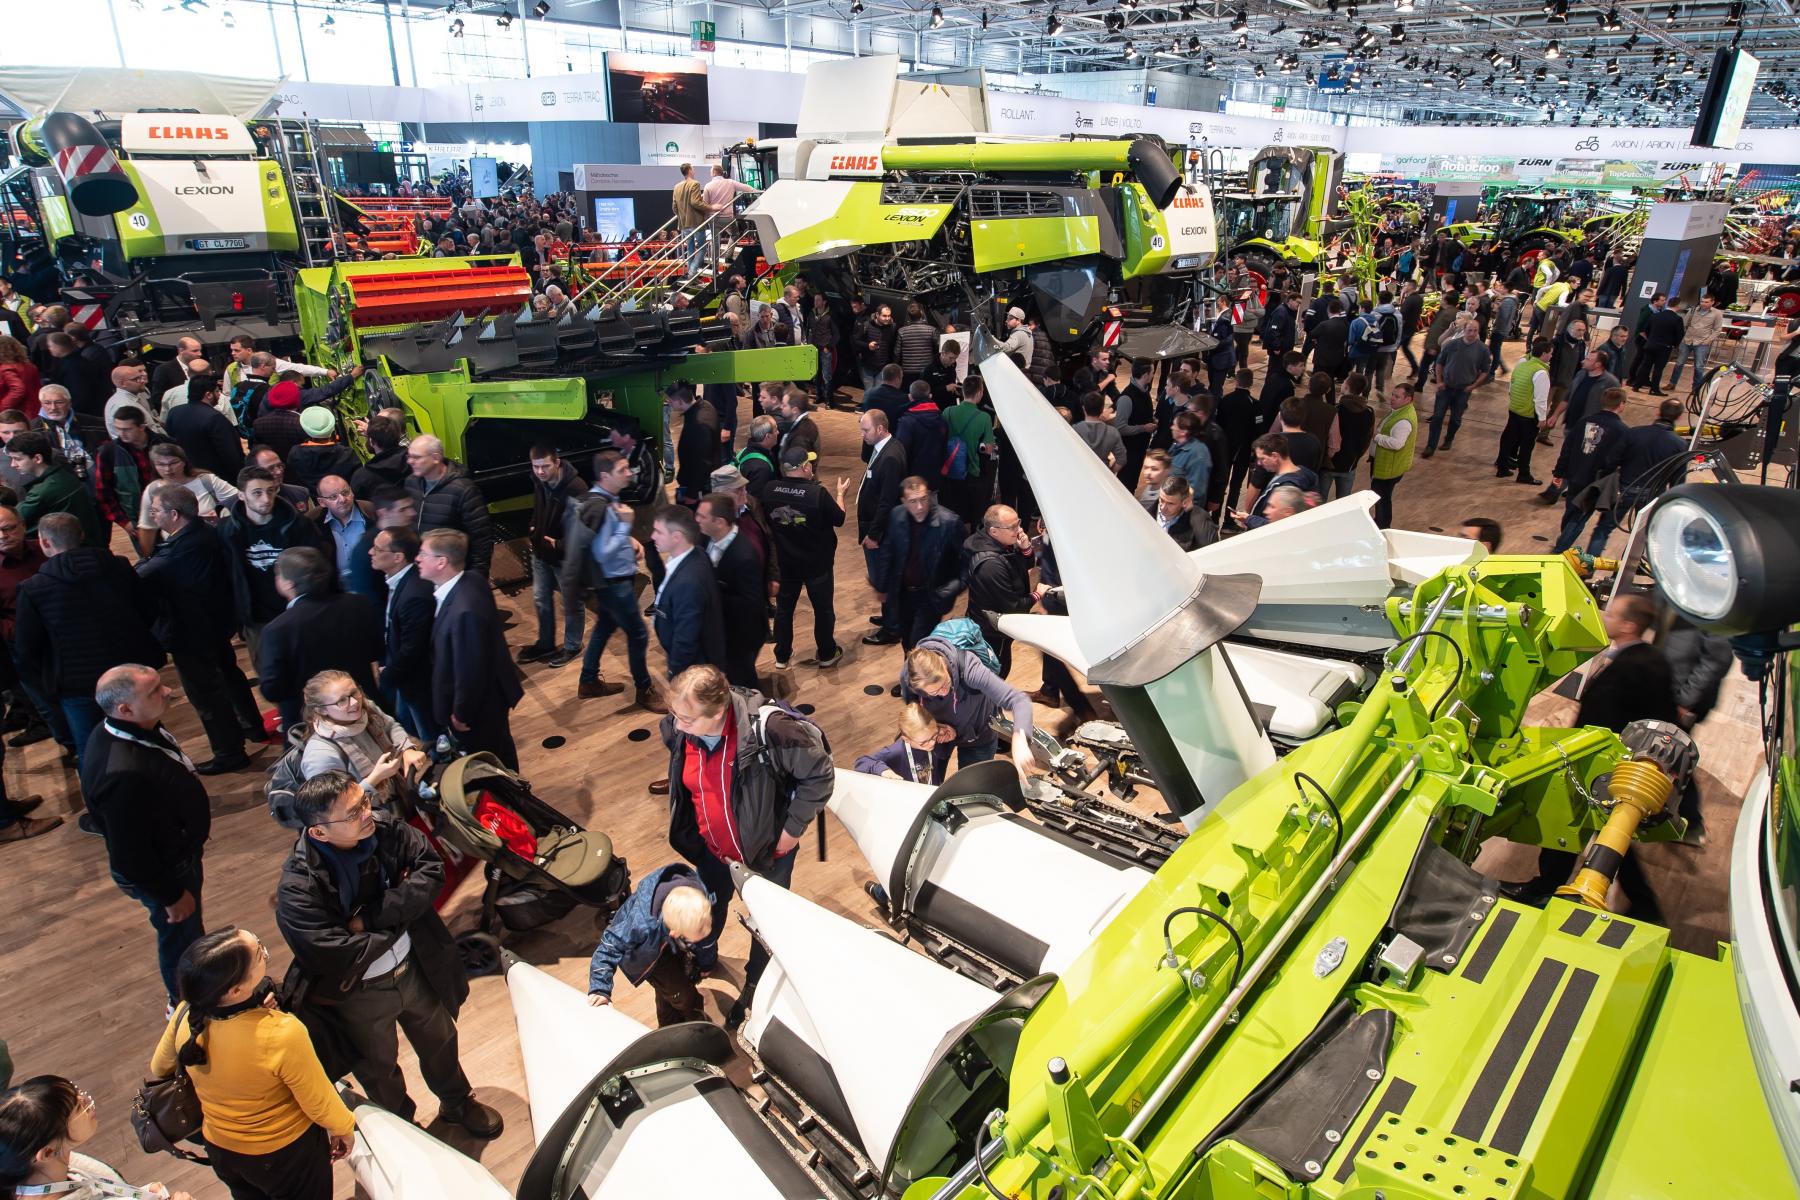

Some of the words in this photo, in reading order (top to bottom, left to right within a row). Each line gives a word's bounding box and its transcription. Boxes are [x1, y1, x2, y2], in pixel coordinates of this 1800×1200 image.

[149, 126, 229, 140] CLAAS
[1611, 140, 1639, 149] AXION
[1646, 140, 1674, 150] ARION
[830, 156, 878, 170] CLAAS
[1396, 156, 1427, 165] garford
[1518, 157, 1553, 166] ZÜRN
[1440, 161, 1499, 174] Robocrop
[1661, 161, 1702, 171] ZÜRN
[175, 185, 234, 195] LEXION
[1174, 197, 1204, 209] CLAAS
[132, 214, 146, 227] 40
[884, 214, 927, 223] LEXION
[1181, 226, 1208, 236] LEXION
[199, 240, 209, 249] GT
[1152, 236, 1163, 248] 40
[773, 486, 806, 496] JAGUAR
